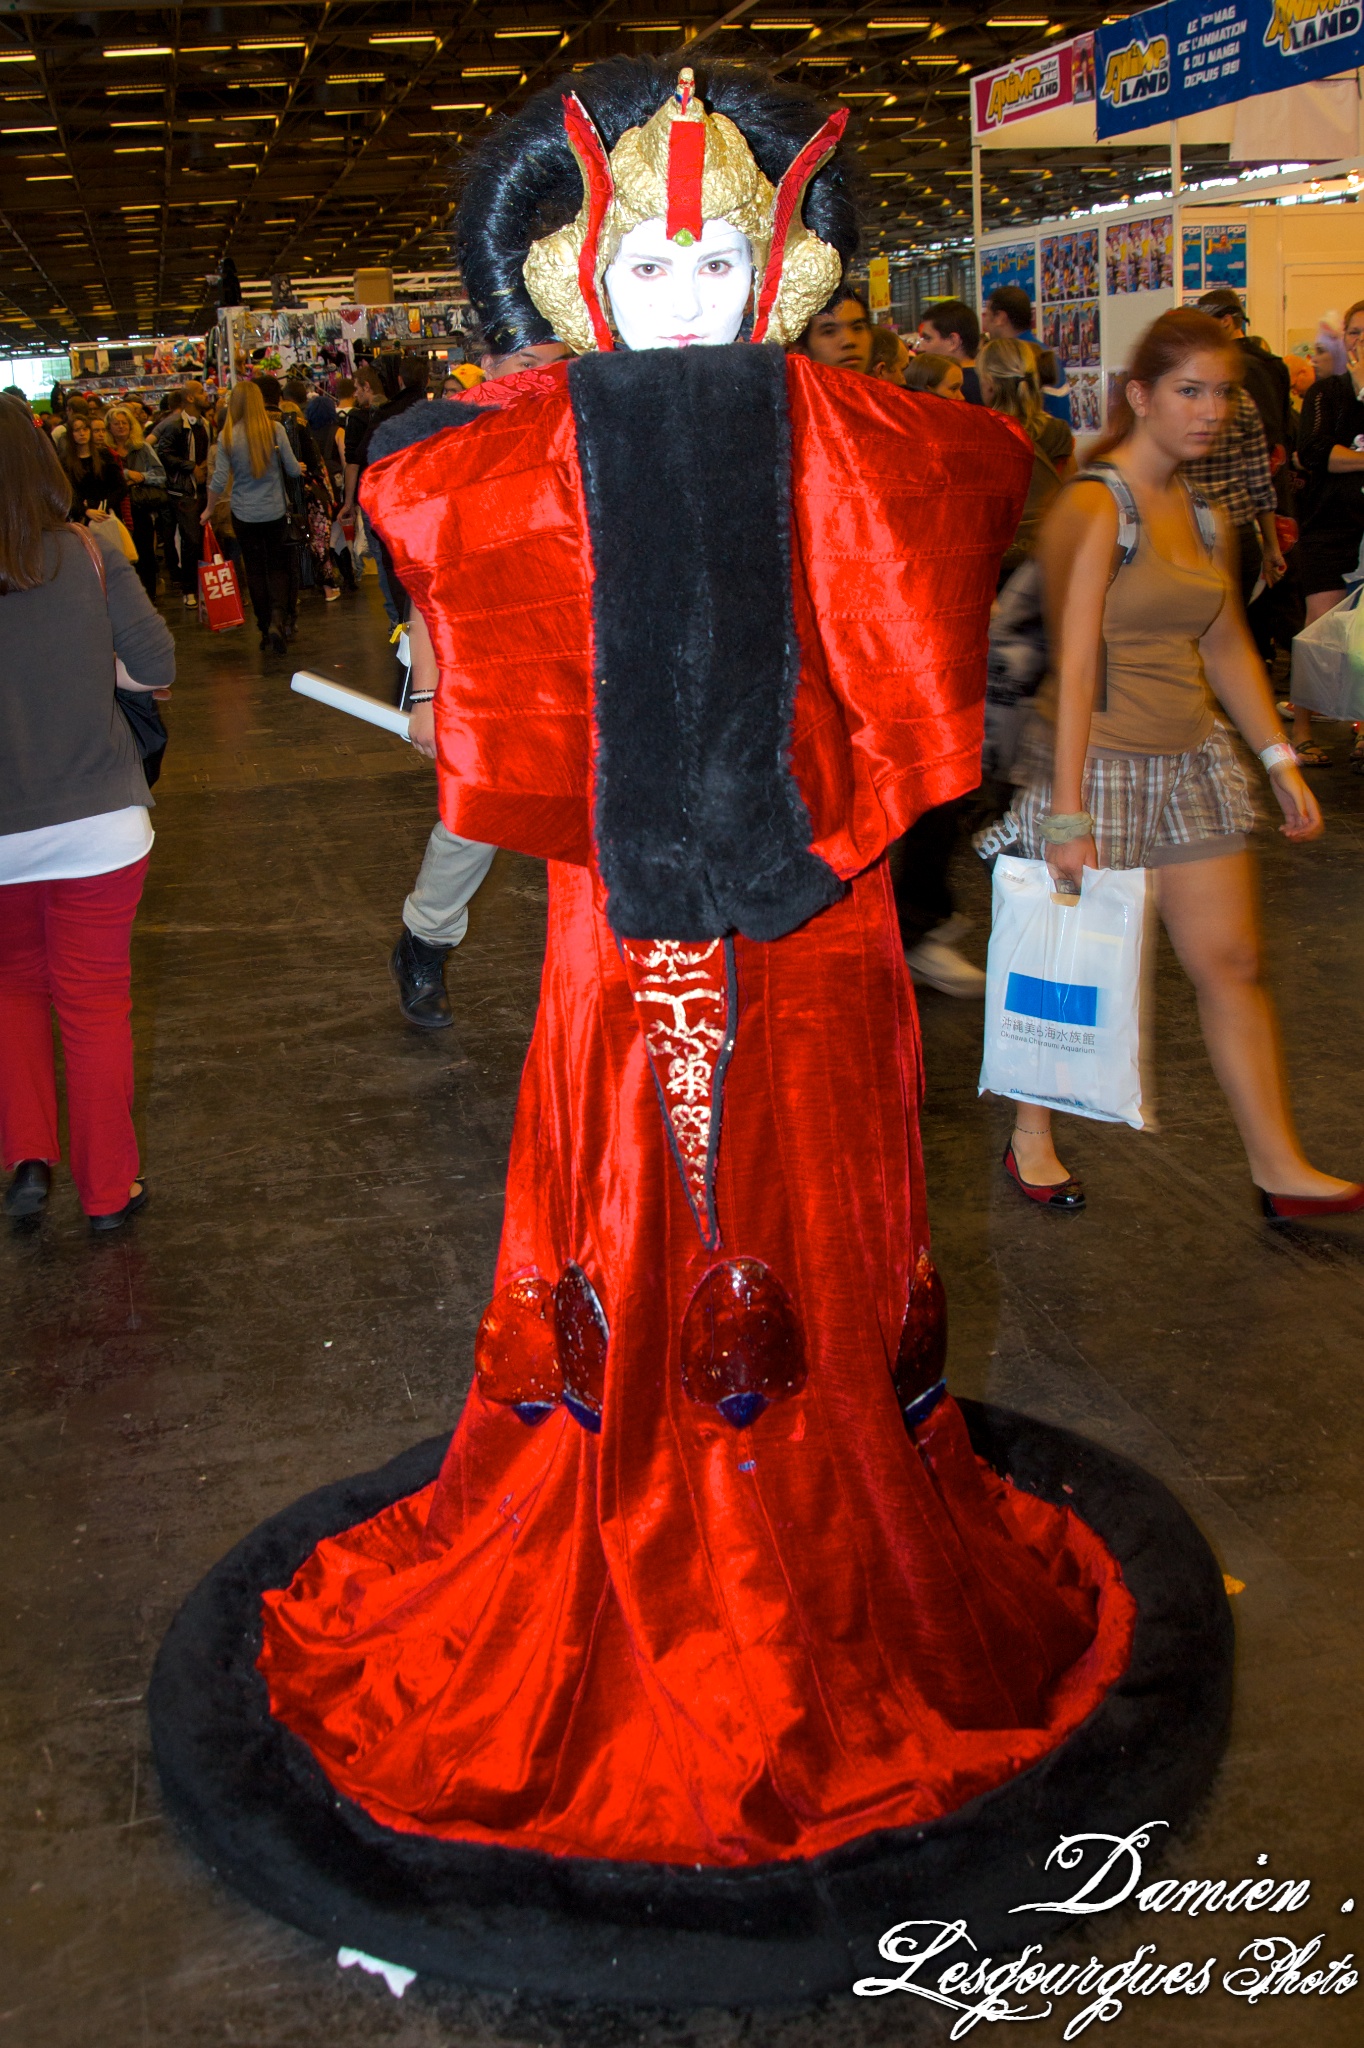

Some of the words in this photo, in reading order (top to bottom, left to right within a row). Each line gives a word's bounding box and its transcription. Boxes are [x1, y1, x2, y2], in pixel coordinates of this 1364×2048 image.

[1187, 18, 1199, 35] LE
[1213, 5, 1236, 25] MAG
[1290, 8, 1360, 50] LAND
[1177, 39, 1191, 56] DE
[1191, 18, 1248, 51] L'ANIMATION
[1183, 57, 1190, 71] &
[1192, 52, 1206, 68] DU
[1207, 40, 1240, 64] MANGA
[1121, 71, 1169, 103] LAND
[1184, 66, 1220, 89] DEPUIS
[1221, 58, 1241, 77] 1991
[1033, 81, 1058, 100] LAND
[1000, 1030, 1028, 1043] Okinawa
[1028, 1036, 1059, 1049] Churaumi
[1060, 1044, 1096, 1054] Aquarium
